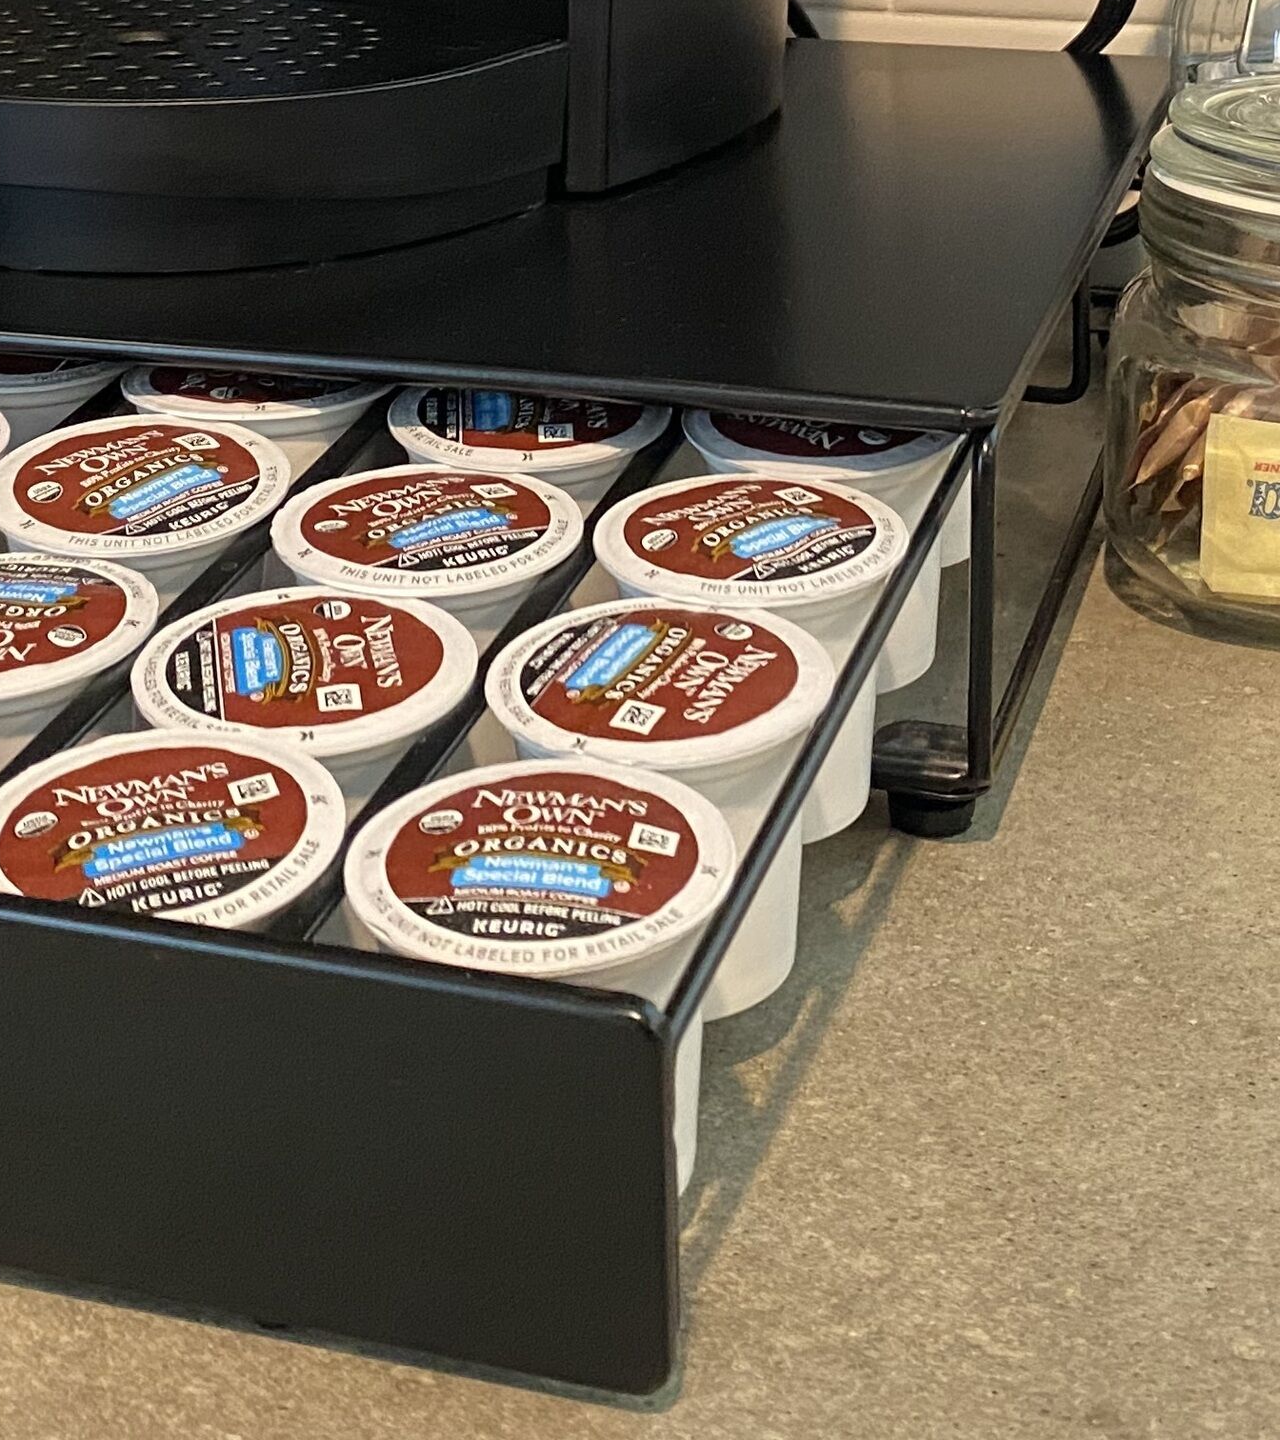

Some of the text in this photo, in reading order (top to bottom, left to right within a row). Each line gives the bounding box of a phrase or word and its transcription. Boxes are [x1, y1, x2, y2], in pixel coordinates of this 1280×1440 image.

[34, 429, 166, 476] NEWMAN'S
[79, 444, 146, 473] OWN
[443, 444, 474, 457] SALE
[84, 453, 204, 507] ORGANICS
[119, 466, 197, 506] Newman's
[173, 470, 213, 488] Blend
[218, 483, 253, 499] PEELING
[168, 503, 226, 531] KEURIG
[372, 485, 443, 518] OWN
[68, 535, 99, 548] THIS
[103, 537, 136, 548] UNIT
[142, 535, 170, 547] NOT
[176, 518, 233, 542] LABELED
[232, 506, 256, 524] FOR
[339, 565, 369, 580] THIS
[372, 571, 407, 584] UNIT
[410, 576, 440, 585] NOT
[446, 564, 508, 584] LABELED
[509, 553, 534, 570] FOR
[442, 546, 506, 569] KEURIG
[699, 582, 732, 594] THIS
[736, 584, 771, 596] UNIT
[777, 582, 807, 593] NOT
[810, 565, 865, 591] LABELED
[604, 627, 688, 701] ORGANICS
[675, 650, 730, 696] OWN
[51, 761, 230, 807] NEWMAN'S
[95, 785, 189, 818] OWN
[472, 789, 648, 816] NEWMAN'S
[503, 804, 597, 827] OWN
[67, 806, 241, 850] ORGANICS
[107, 826, 212, 856] Newman's
[94, 832, 233, 873] Special Blend
[453, 835, 628, 865] ORGANICS
[484, 856, 591, 873] Newman's
[139, 858, 270, 891] COOL BEFORE PEELING
[212, 837, 321, 922] FOR RETAIL SALE
[464, 867, 603, 890] Special Blend
[132, 884, 216, 913] KEURIG
[490, 901, 521, 915] COOL
[523, 903, 569, 919] BEFORE
[571, 908, 621, 925] PEELING
[419, 931, 453, 953] NOT
[455, 939, 536, 962] LABELED
[542, 940, 579, 961] FOR
[585, 931, 646, 956] RETAIL
[648, 907, 684, 936] SALE
[472, 918, 560, 938] KEURIG
